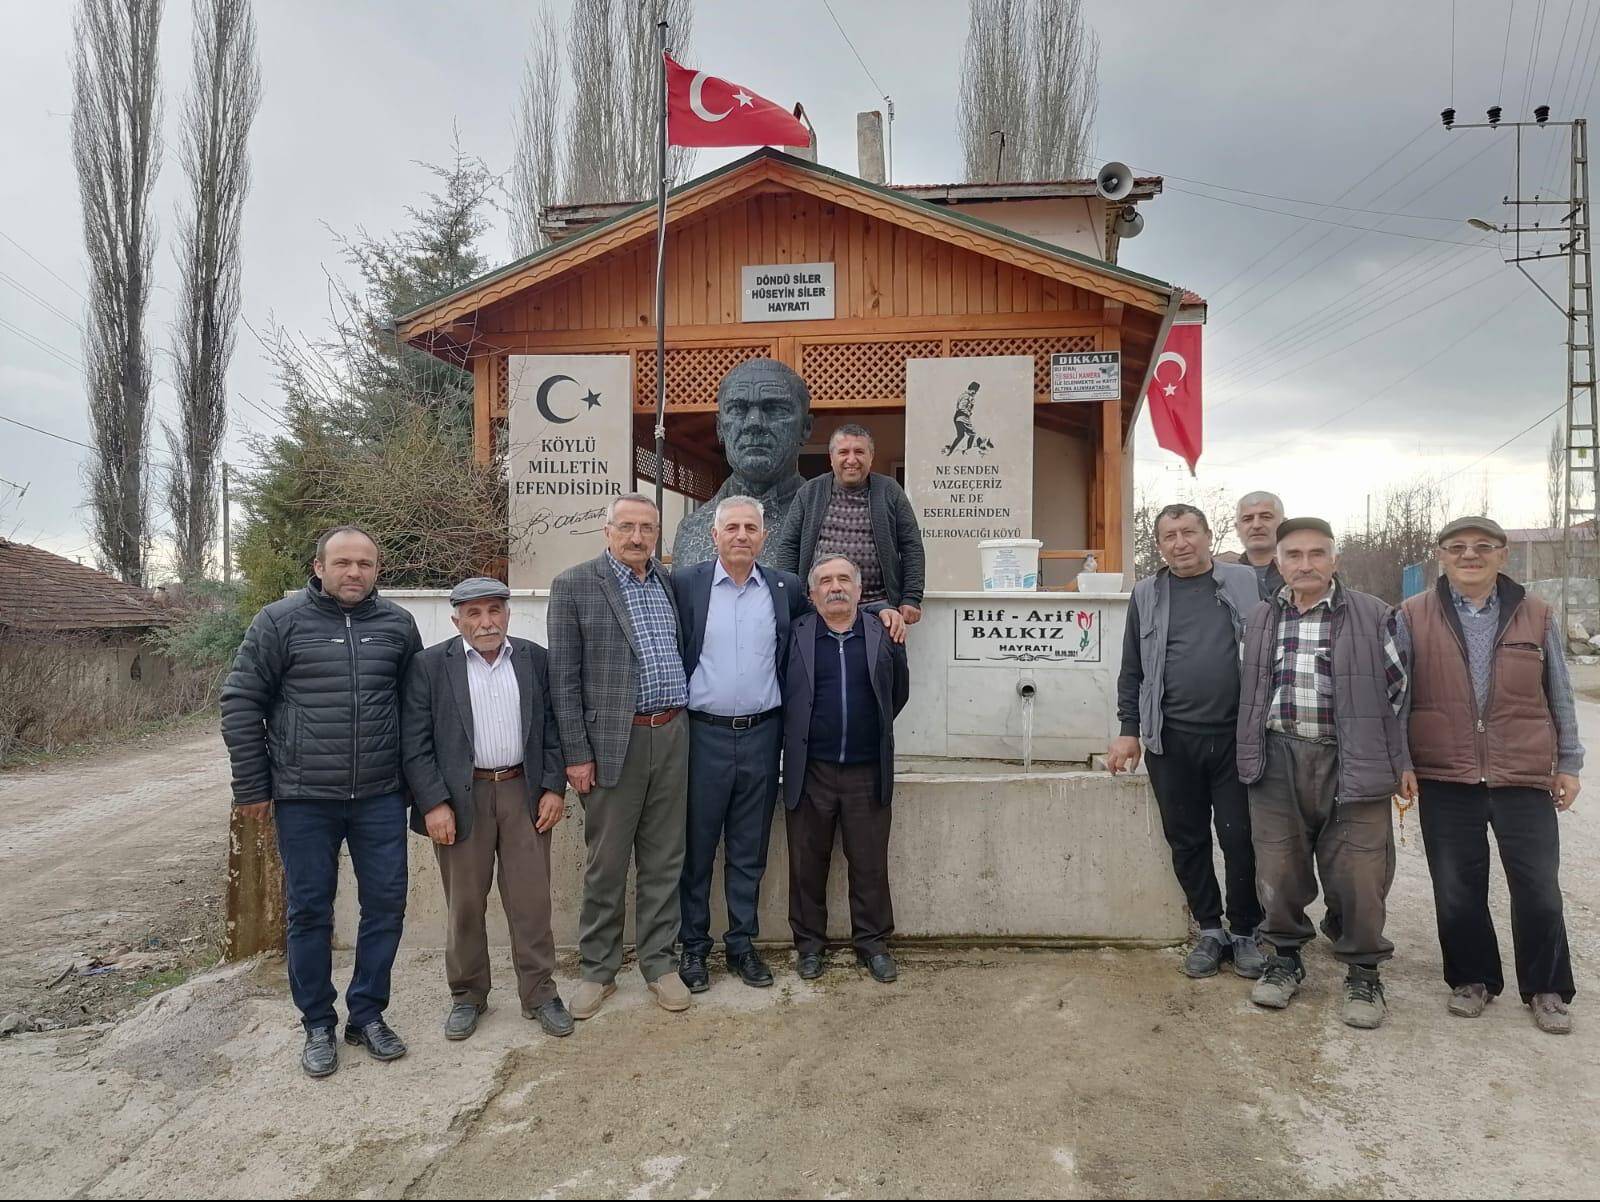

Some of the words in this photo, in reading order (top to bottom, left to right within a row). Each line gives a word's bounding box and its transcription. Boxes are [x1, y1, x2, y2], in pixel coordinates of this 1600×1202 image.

[756, 273, 790, 286] DÖNDÜ
[793, 272, 822, 284] SİLER
[751, 286, 795, 299] HÜSEYİN
[797, 285, 826, 298] SİLER
[768, 301, 810, 313] HAYRATI
[541, 435, 597, 453] KÖYLÜ
[528, 457, 609, 475] MİLLETİN
[936, 465, 951, 476] NE
[953, 465, 1000, 476] SENDEN
[515, 478, 622, 496] EFENDİSİDİR
[933, 477, 1003, 491] VAZGEÇERİZ
[950, 494, 966, 504] NE
[968, 494, 984, 504] DE
[923, 506, 1010, 518] ESERLERİNDEN
[919, 527, 990, 539] İSLEROVACIĞI
[993, 527, 1021, 539] KÖYÜ
[963, 609, 1005, 622] Elif
[1026, 610, 1075, 622] Arif
[971, 626, 1064, 639] BALKIZ
[999, 644, 1053, 652] HAYRATI
